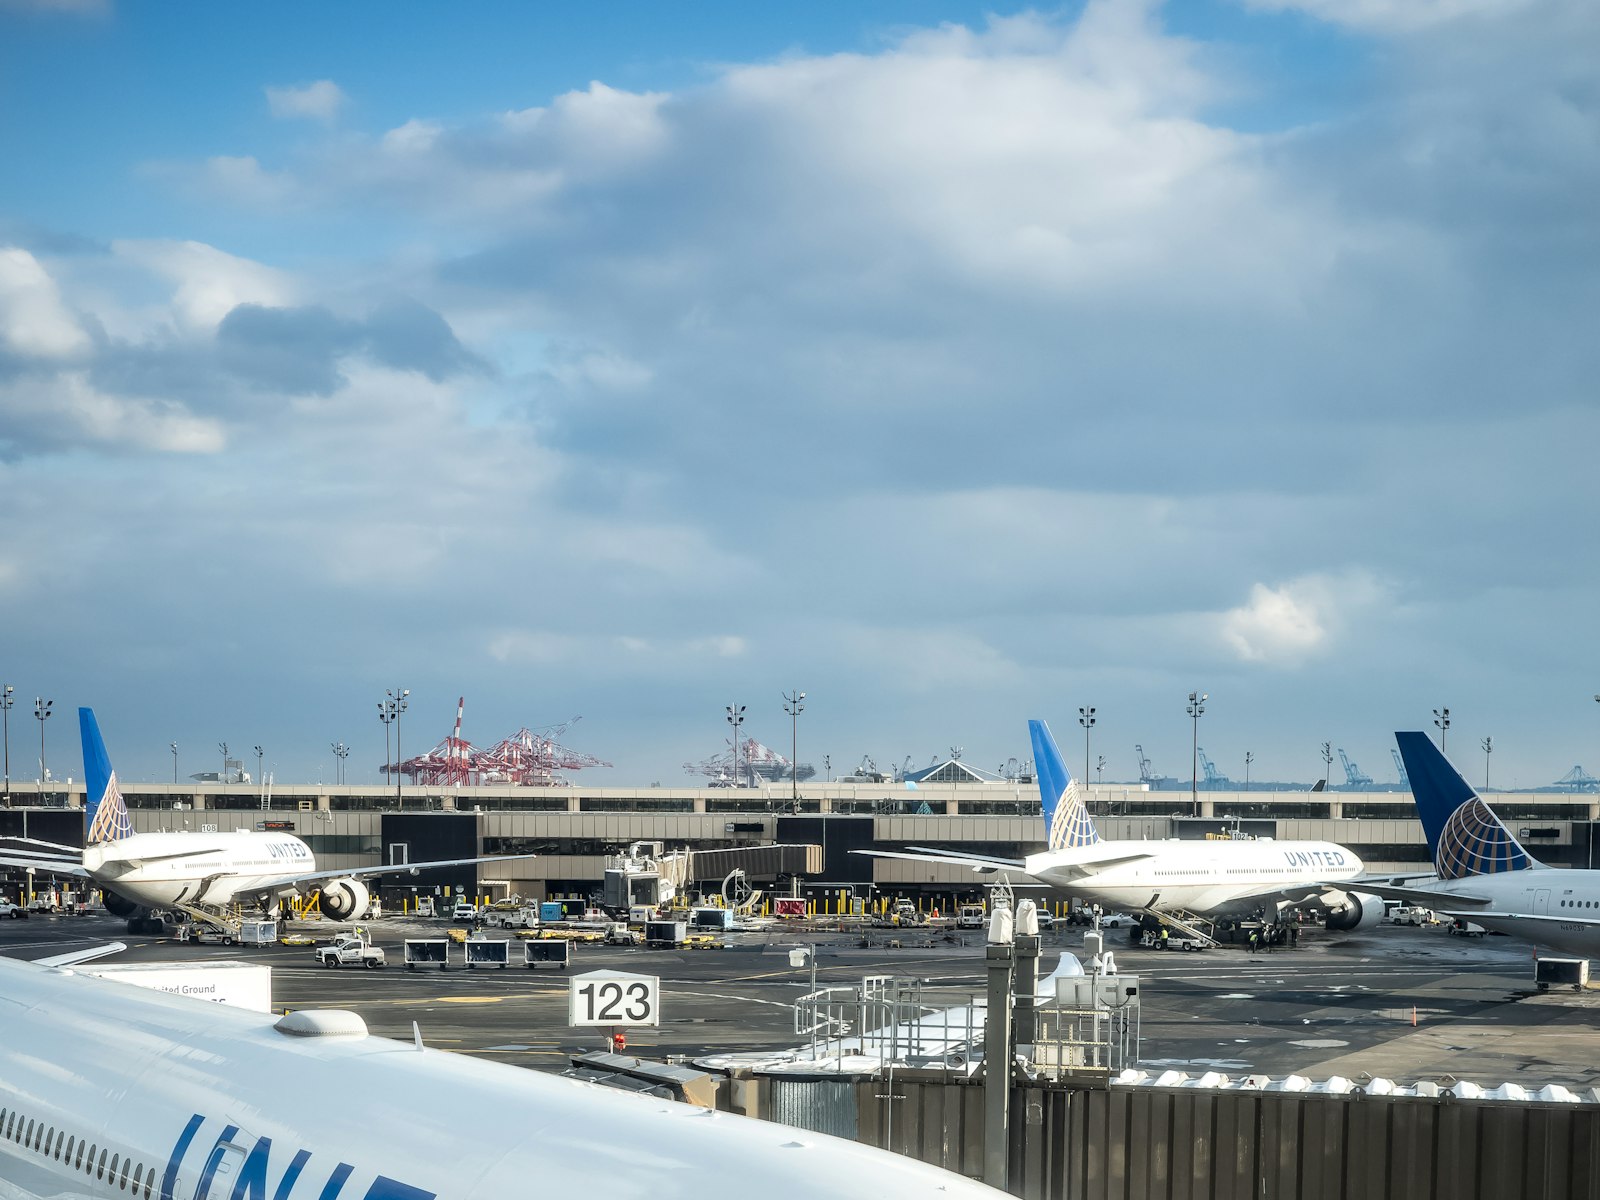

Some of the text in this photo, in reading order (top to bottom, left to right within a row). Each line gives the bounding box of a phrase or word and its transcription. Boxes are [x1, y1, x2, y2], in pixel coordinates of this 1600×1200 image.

[202, 824, 216, 832] 108
[1233, 833, 1246, 841] 102
[265, 842, 307, 858] UNITED
[1284, 851, 1346, 867] UNITED
[182, 984, 216, 994] Ground
[579, 982, 651, 1021] 123
